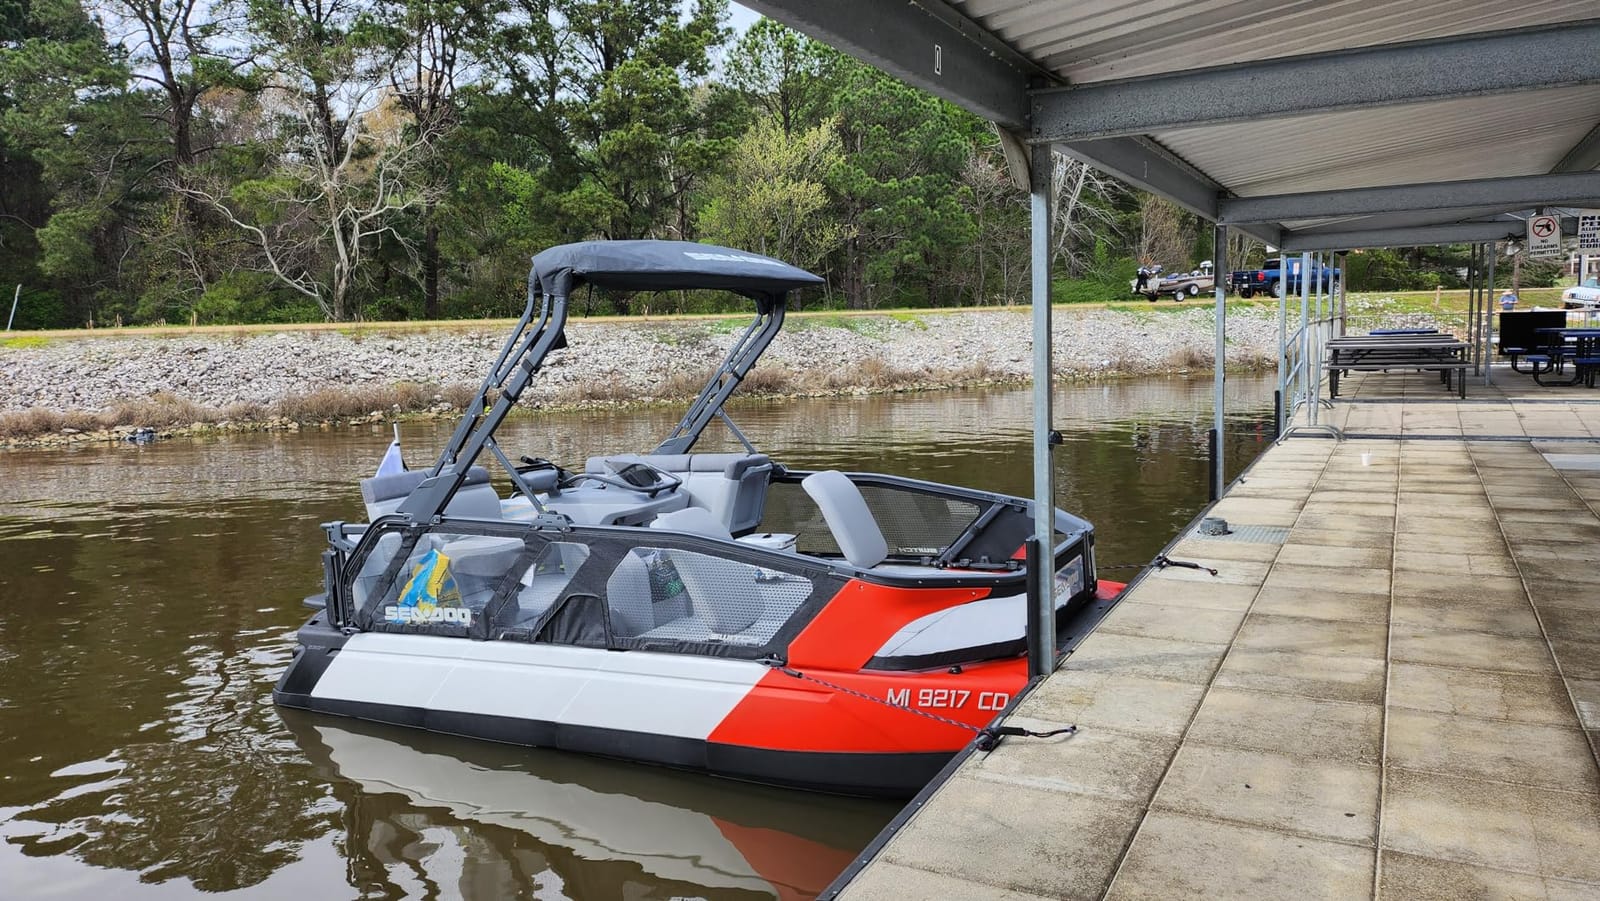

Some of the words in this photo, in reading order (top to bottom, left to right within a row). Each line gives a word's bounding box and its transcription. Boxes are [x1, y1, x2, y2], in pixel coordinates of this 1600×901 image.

[886, 688, 911, 707] MI
[918, 689, 971, 708] 9217
[978, 692, 1010, 711] CD
